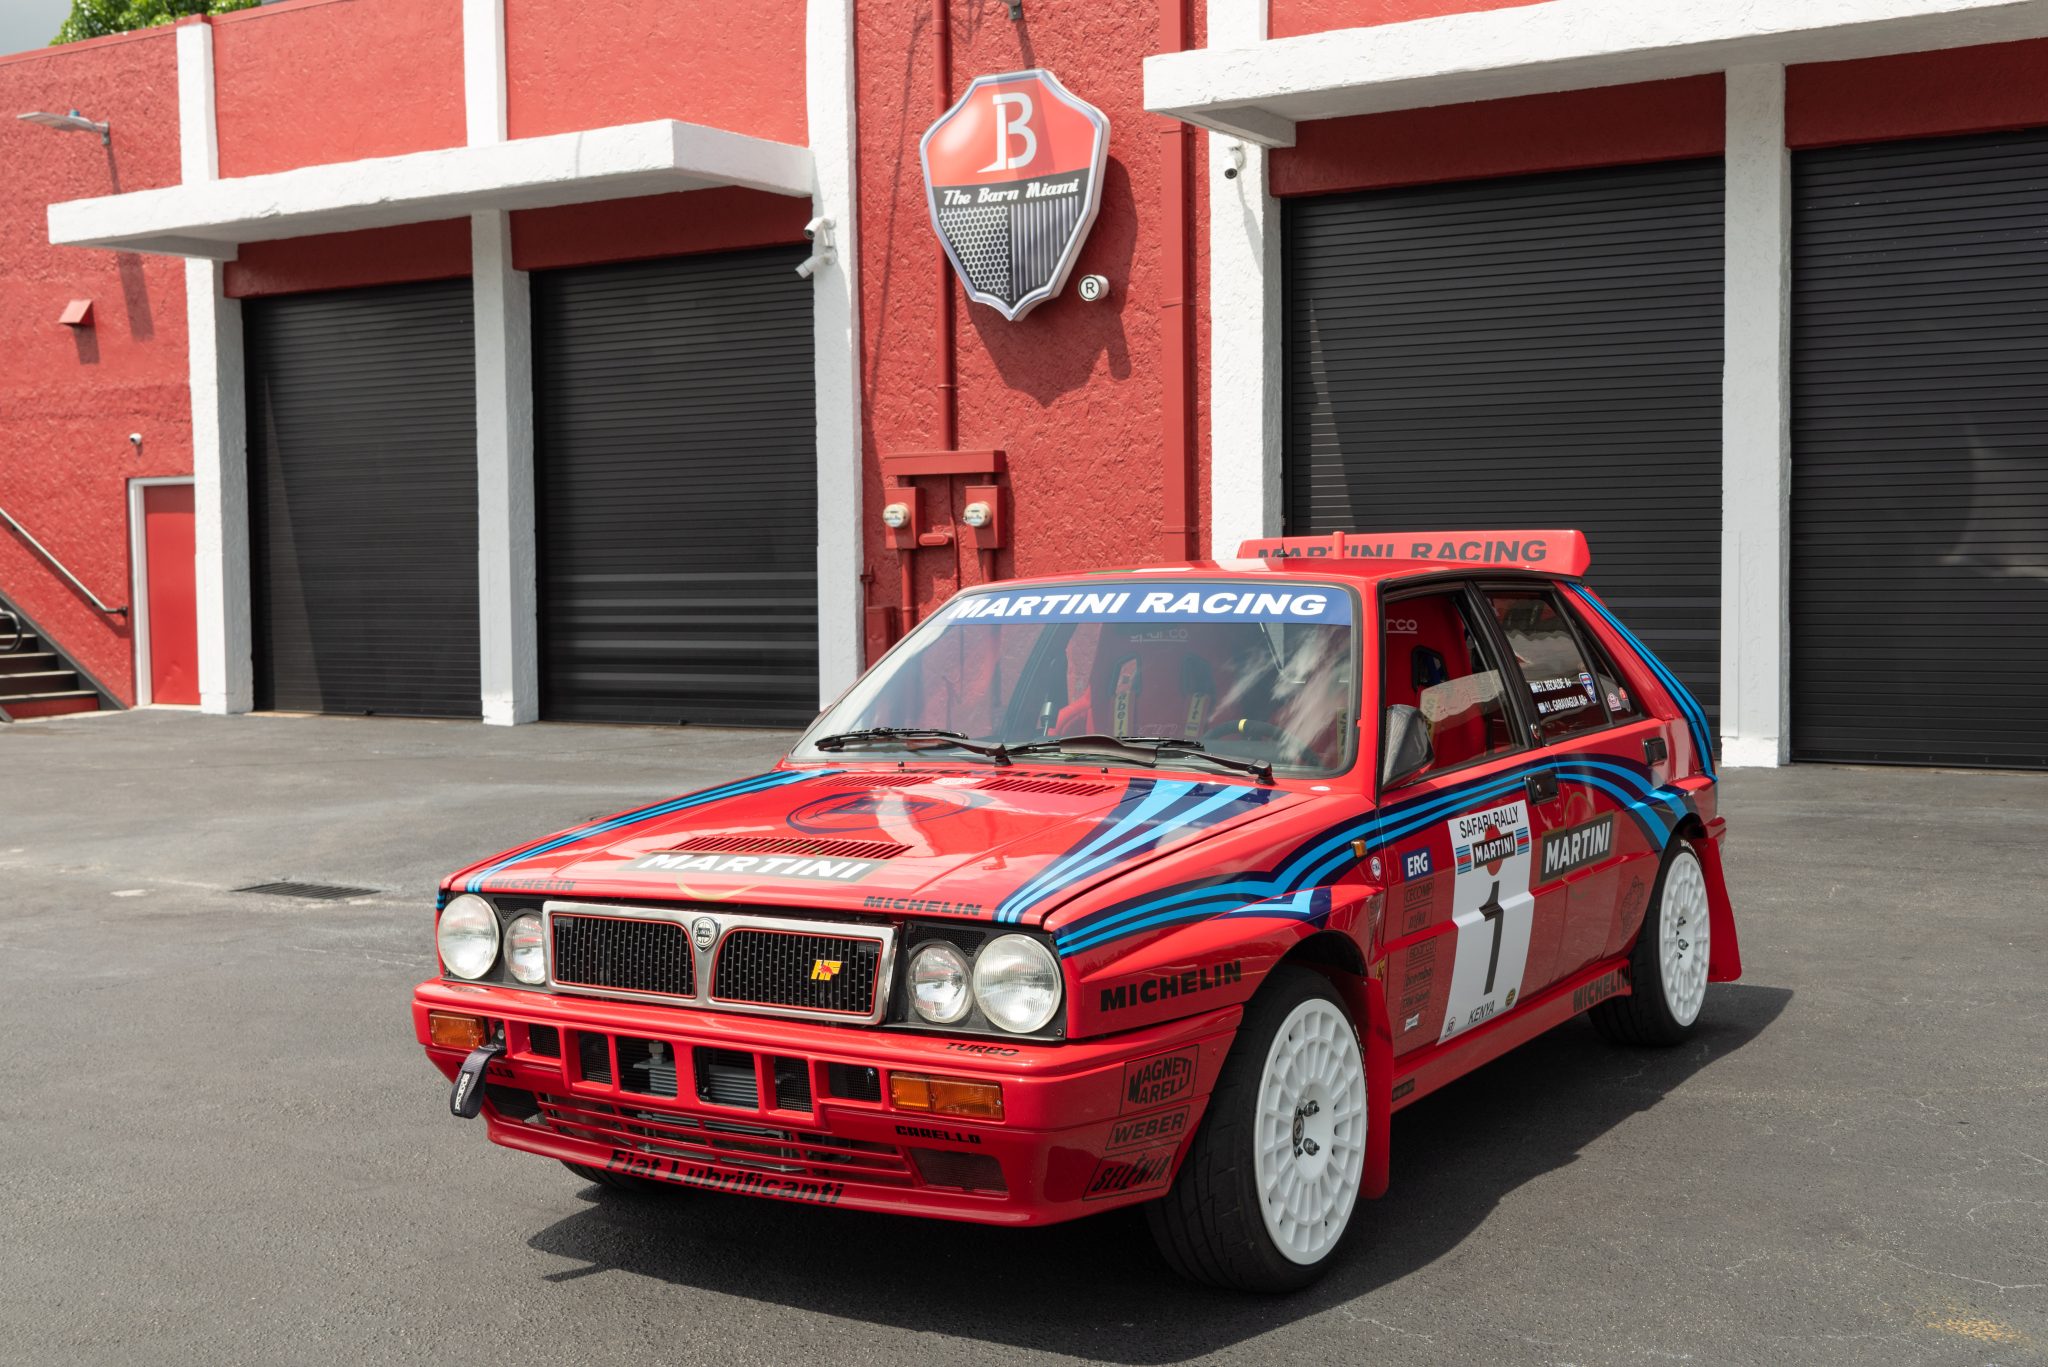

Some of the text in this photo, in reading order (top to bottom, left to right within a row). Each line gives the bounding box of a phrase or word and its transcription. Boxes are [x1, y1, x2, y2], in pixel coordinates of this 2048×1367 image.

[976, 92, 1037, 173] B
[944, 178, 1079, 206] The Barn Miami
[1410, 539, 1548, 564] RACING
[946, 592, 1328, 620] MARTINI RACING
[1459, 805, 1519, 839] SAFARI RALLY
[1474, 839, 1515, 865] MARTINI
[1545, 821, 1611, 874] MARTINI
[637, 853, 871, 880] MARTINI
[1407, 852, 1429, 877] ERG
[489, 878, 576, 891] MICHELIN
[863, 895, 983, 916] MICHELIN
[1478, 880, 1505, 996] 1
[1100, 960, 1242, 1012] MICHELIN
[1573, 966, 1632, 1013] MICHELIN
[1467, 1000, 1496, 1025] KENYA
[947, 1042, 1020, 1057] TURBO
[895, 1125, 982, 1145] CARELLO
[1114, 1112, 1185, 1144] WEBER
[606, 1149, 844, 1205] Fiat Lubrificanti
